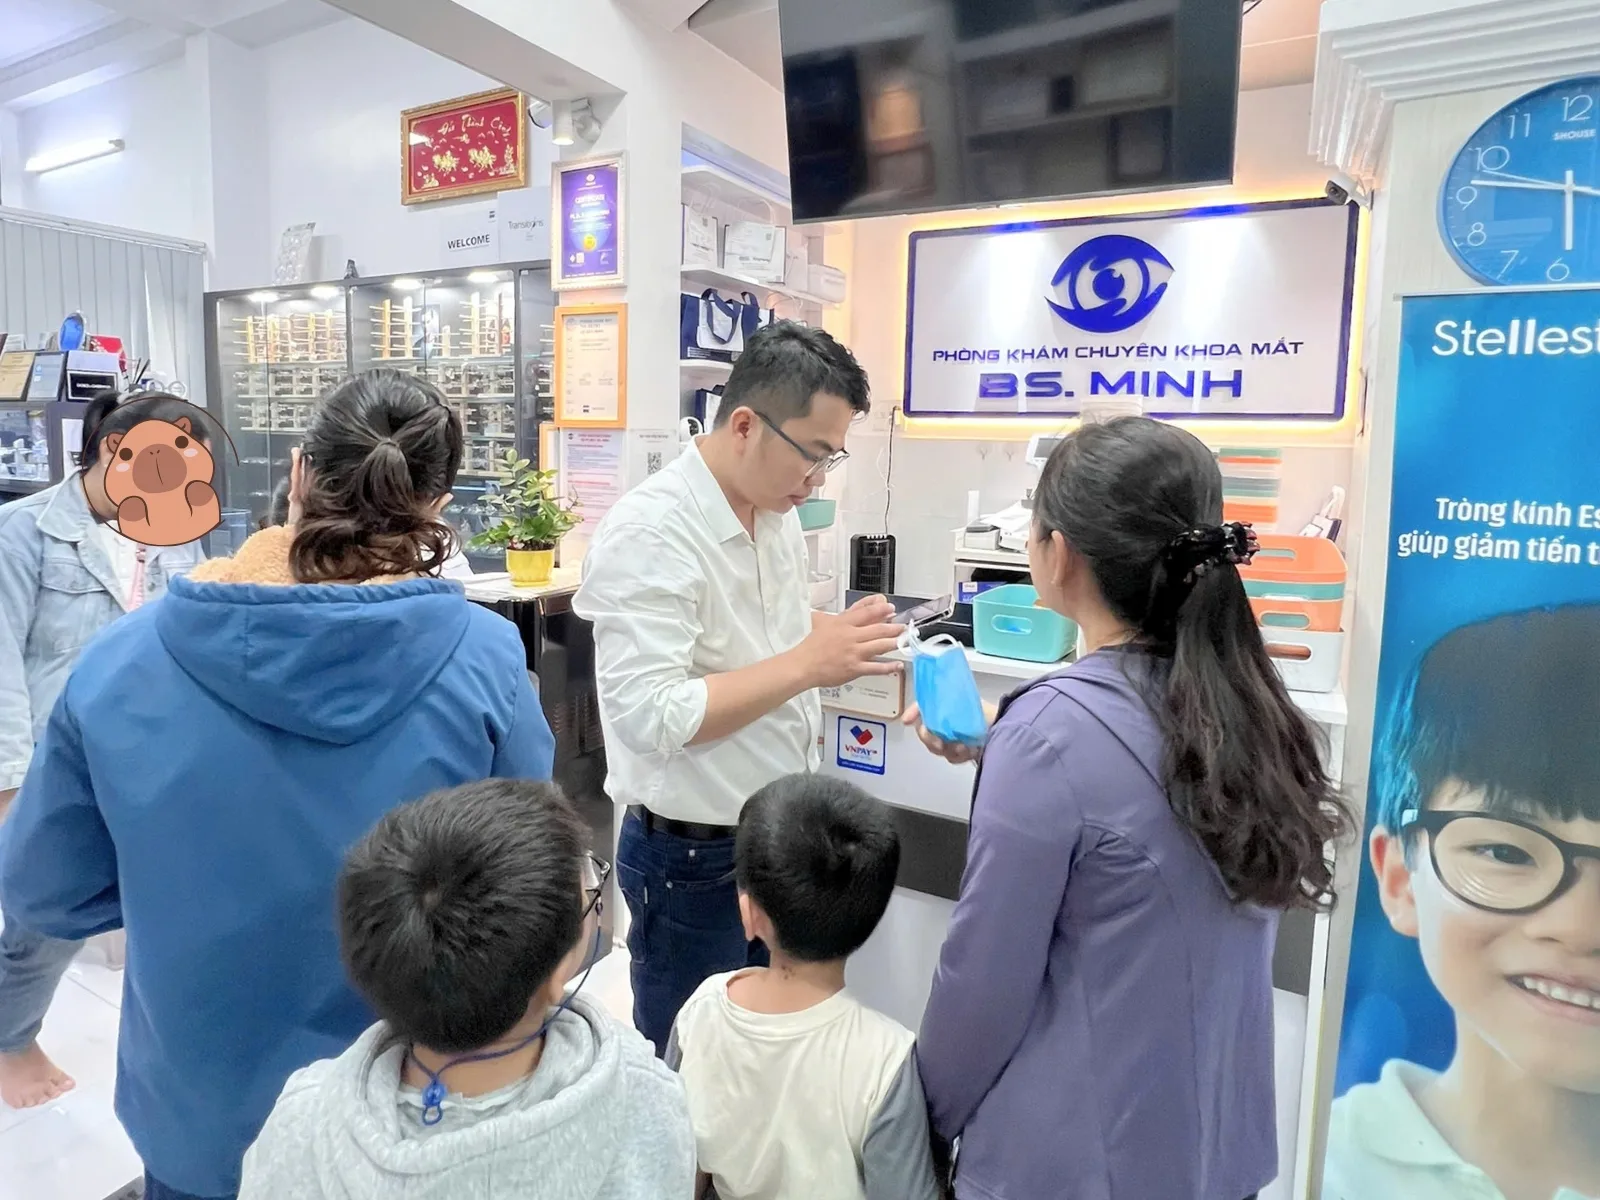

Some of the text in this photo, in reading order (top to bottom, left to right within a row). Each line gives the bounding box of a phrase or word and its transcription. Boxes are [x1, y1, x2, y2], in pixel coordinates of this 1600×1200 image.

[1562, 94, 1593, 122] 12
[1508, 113, 1531, 139] 11
[1474, 146, 1510, 171] 10
[1456, 186, 1478, 210] 9
[447, 234, 491, 249] WELCOME
[1467, 222, 1487, 246] 8
[1497, 250, 1519, 279] 7
[1546, 257, 1570, 282] 6
[932, 337, 1304, 362] PHÒNG KHÁM CHUYÊN KHOA MẮT
[978, 369, 1242, 398] BS. MINH
[1436, 498, 1507, 527] Tròng
[1512, 500, 1571, 527] kính
[1397, 530, 1449, 559] giúp
[1453, 532, 1520, 560] giảm
[1527, 535, 1581, 564] tiến
